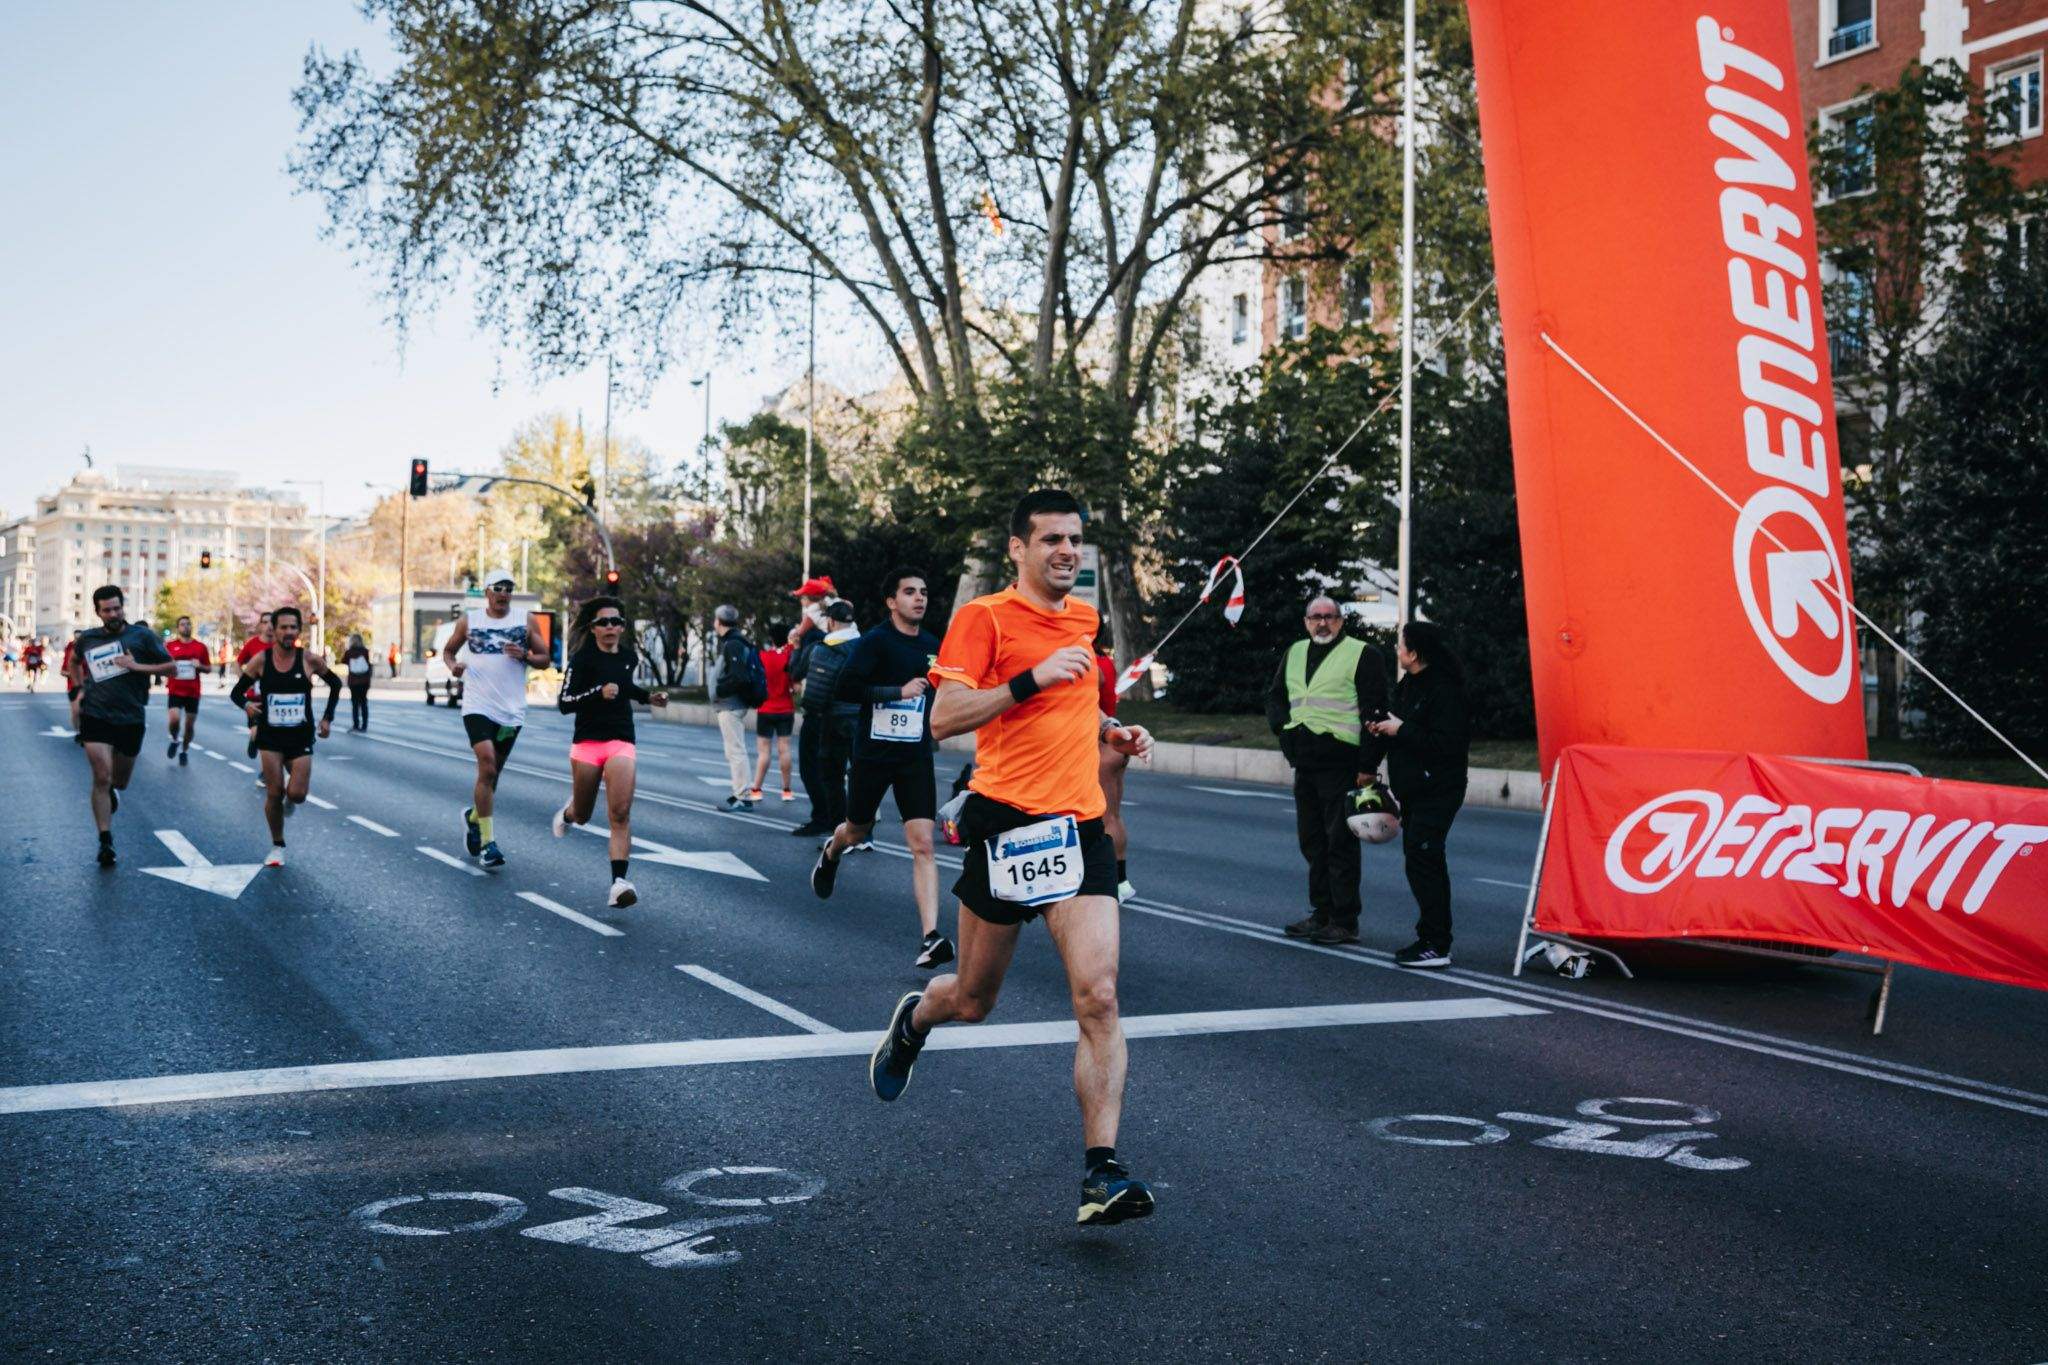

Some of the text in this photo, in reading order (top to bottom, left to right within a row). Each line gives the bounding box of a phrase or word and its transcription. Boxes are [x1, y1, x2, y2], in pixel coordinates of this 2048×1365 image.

[1696, 15, 1829, 498] ENERVIT
[890, 713, 908, 727] 89
[1007, 854, 1067, 885] 1645
[1695, 794, 2048, 914] ENERVIT
